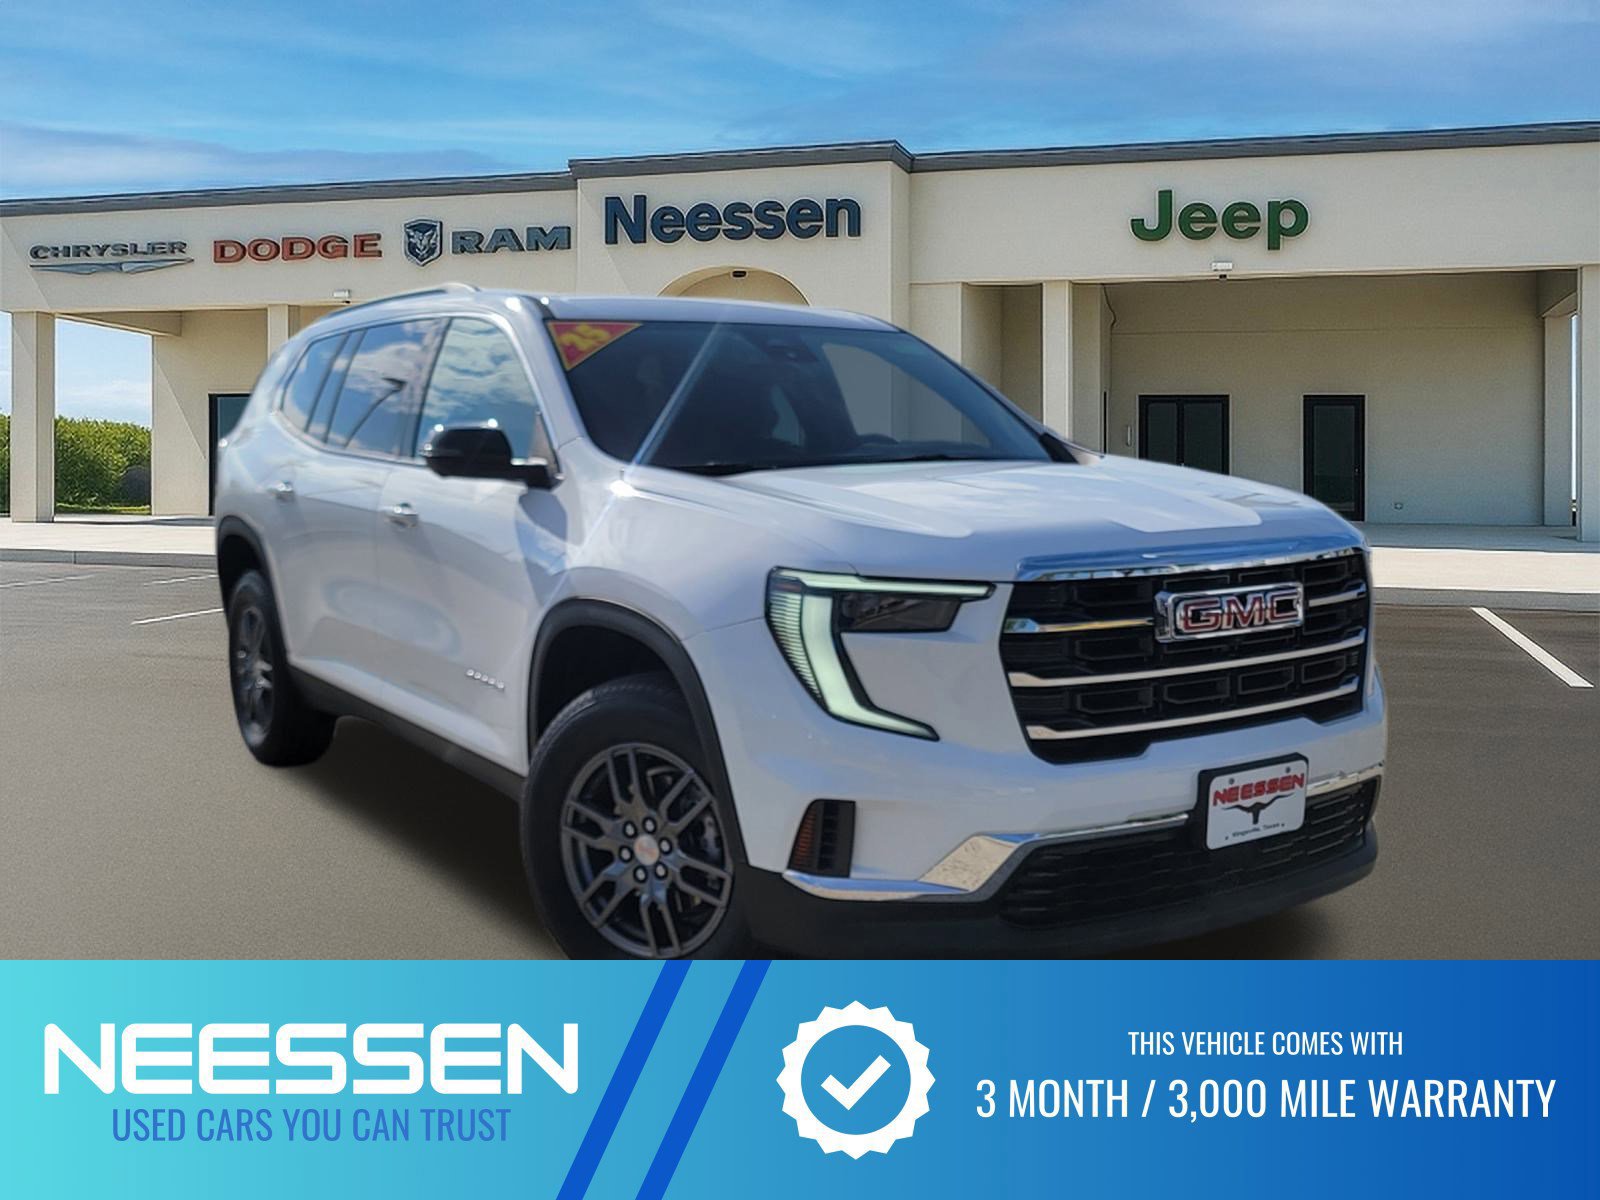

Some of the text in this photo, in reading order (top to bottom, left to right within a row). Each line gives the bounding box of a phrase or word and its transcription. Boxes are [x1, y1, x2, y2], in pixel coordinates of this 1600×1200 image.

[605, 194, 861, 245] Neessen
[1130, 189, 1310, 251] Jeep
[29, 240, 188, 260] CHRYSLER
[213, 232, 383, 264] DODGE
[451, 225, 571, 254] RAM
[1176, 588, 1302, 633] GMC
[1212, 773, 1306, 807] NEESSEN
